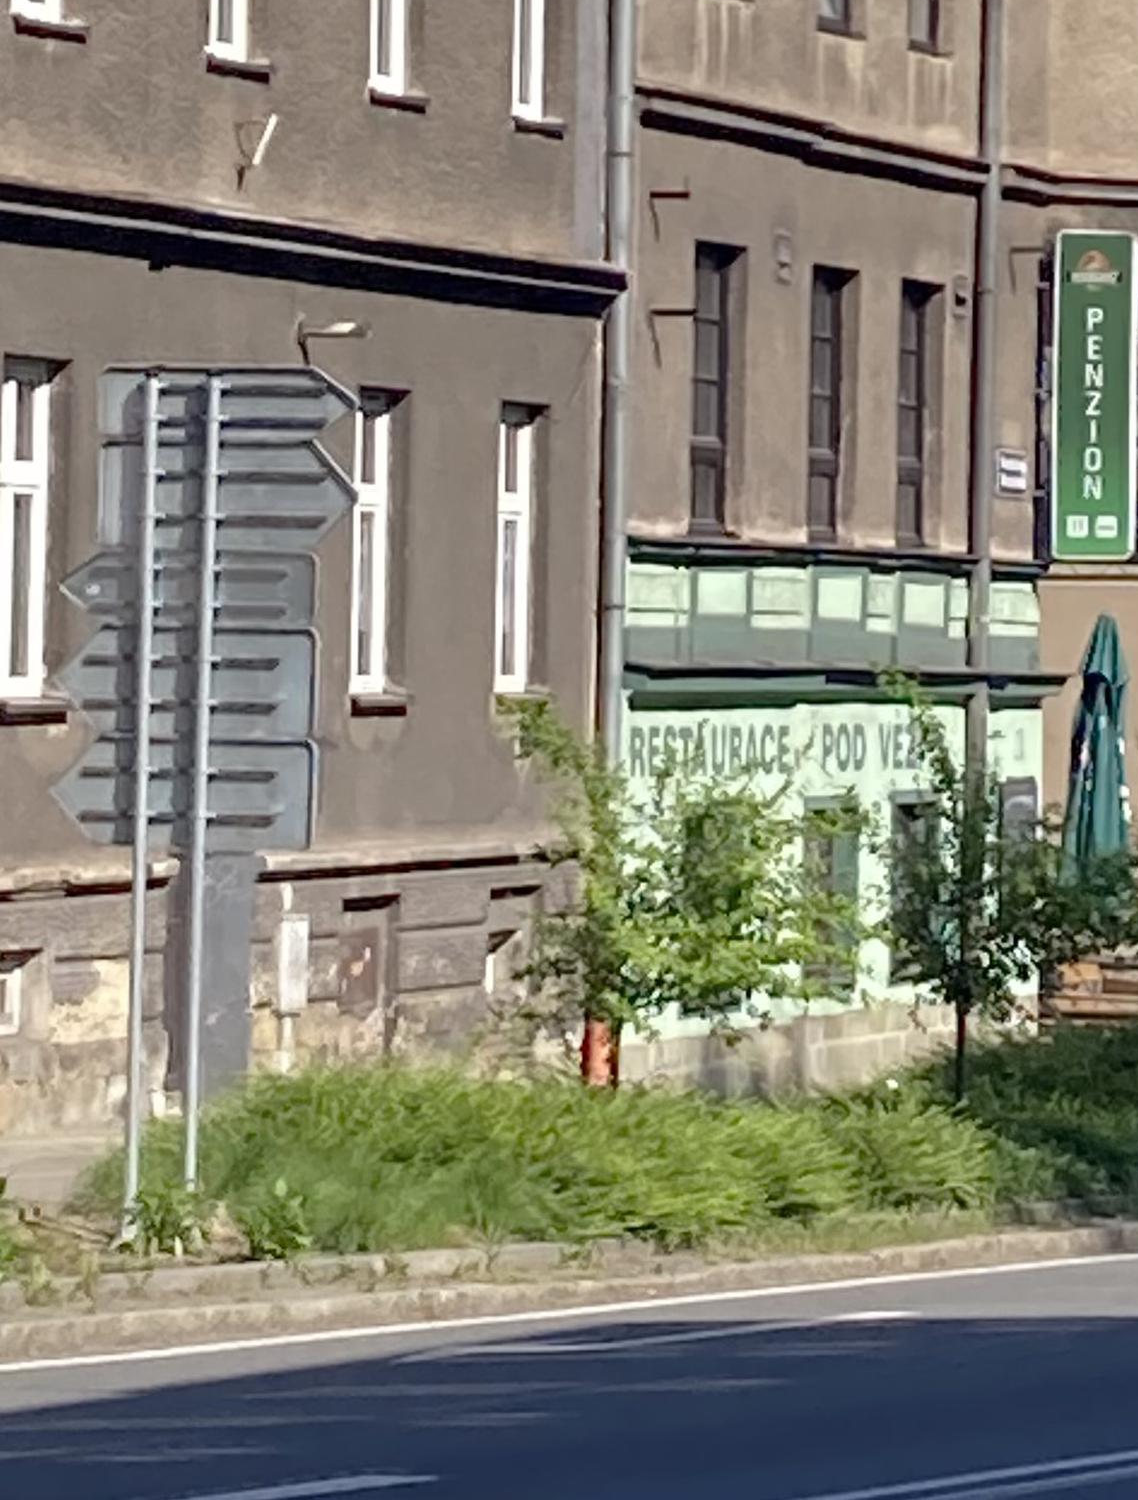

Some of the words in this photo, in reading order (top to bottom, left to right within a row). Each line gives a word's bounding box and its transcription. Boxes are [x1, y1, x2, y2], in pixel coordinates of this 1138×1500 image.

[1083, 307, 1105, 501] PENZION
[630, 722, 790, 778] RESTAURACE
[822, 722, 866, 772] POD
